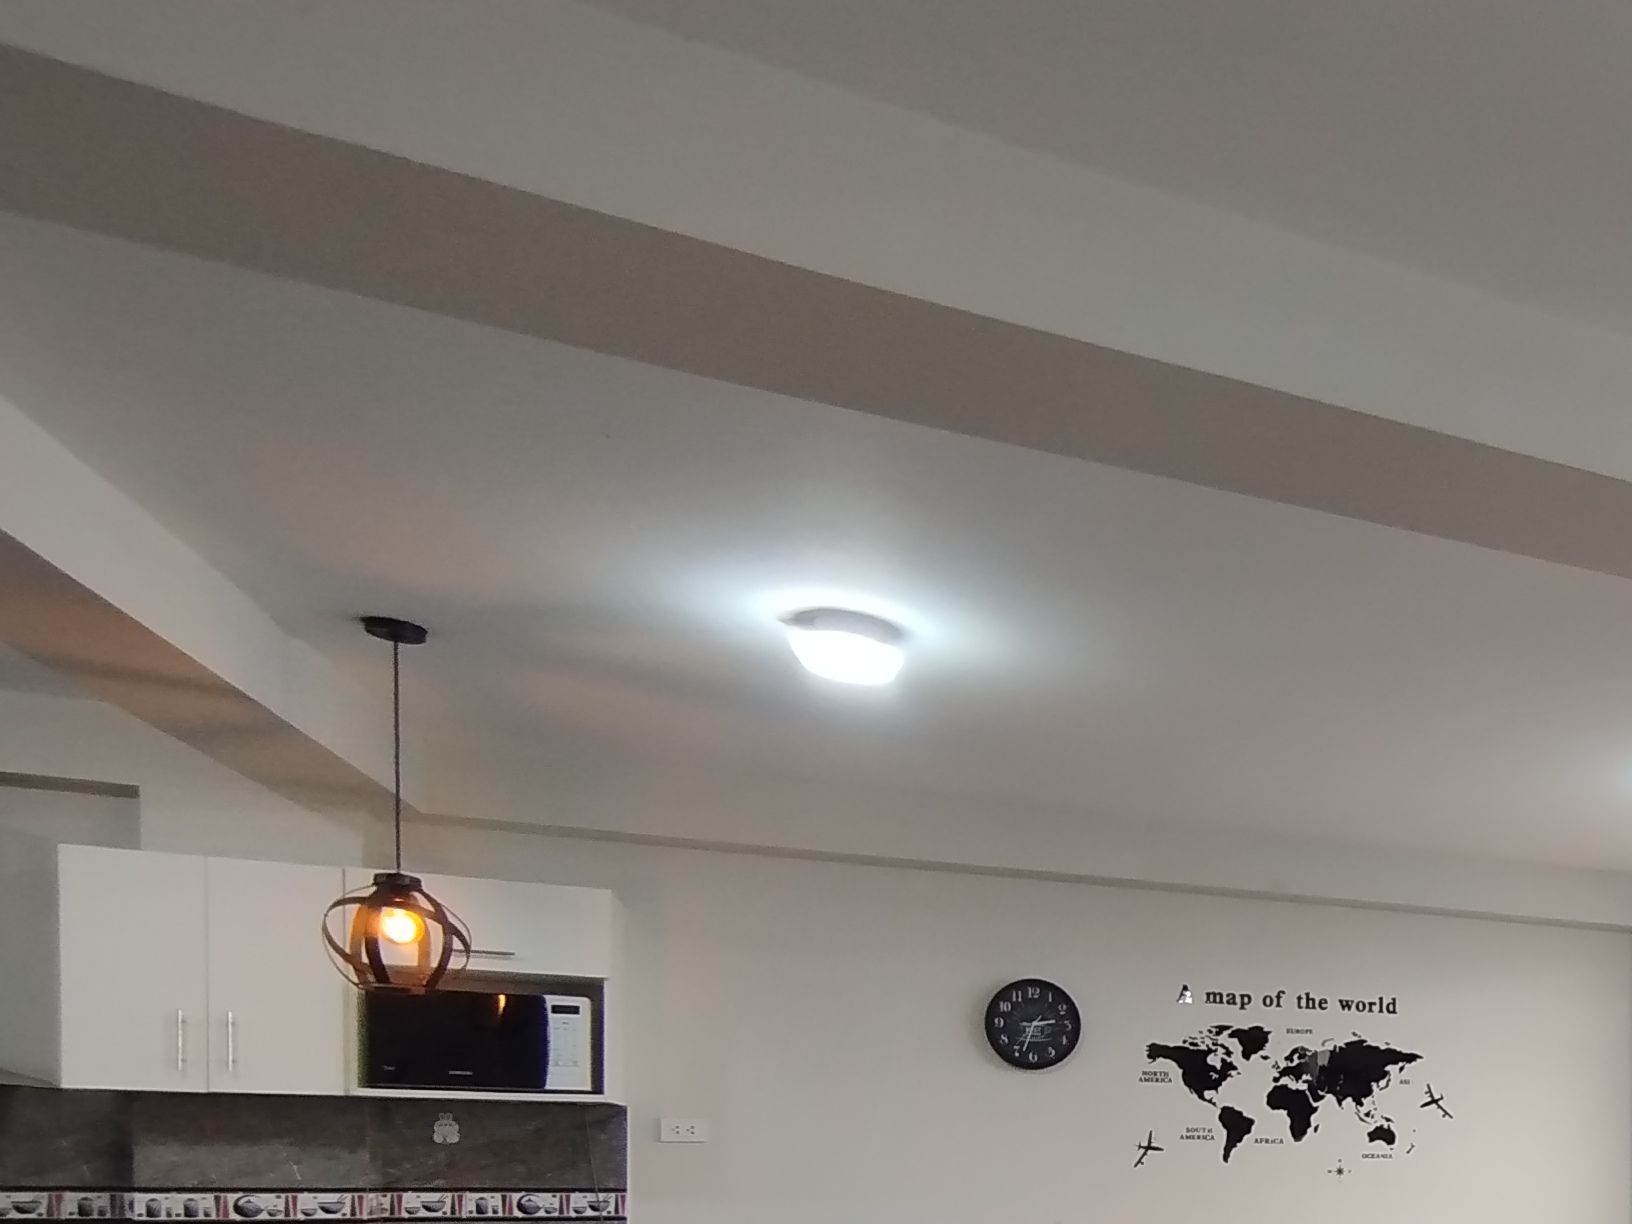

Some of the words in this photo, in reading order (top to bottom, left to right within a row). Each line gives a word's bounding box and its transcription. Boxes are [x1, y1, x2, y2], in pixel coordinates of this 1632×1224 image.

[1012, 990, 1022, 1002] 11
[1027, 986, 1041, 998] 12
[1048, 991, 1053, 1003] 1
[1176, 984, 1193, 1004] A
[1204, 990, 1252, 1010] map
[1262, 990, 1286, 1008] of
[1296, 992, 1329, 1010] the
[1338, 997, 1398, 1014] world
[1000, 1000, 1012, 1013] 10
[994, 1017, 1005, 1029] 9
[1064, 1020, 1073, 1032] 3
[1028, 1051, 1039, 1063] 6
[1138, 1076, 1173, 1084] AMERICA
